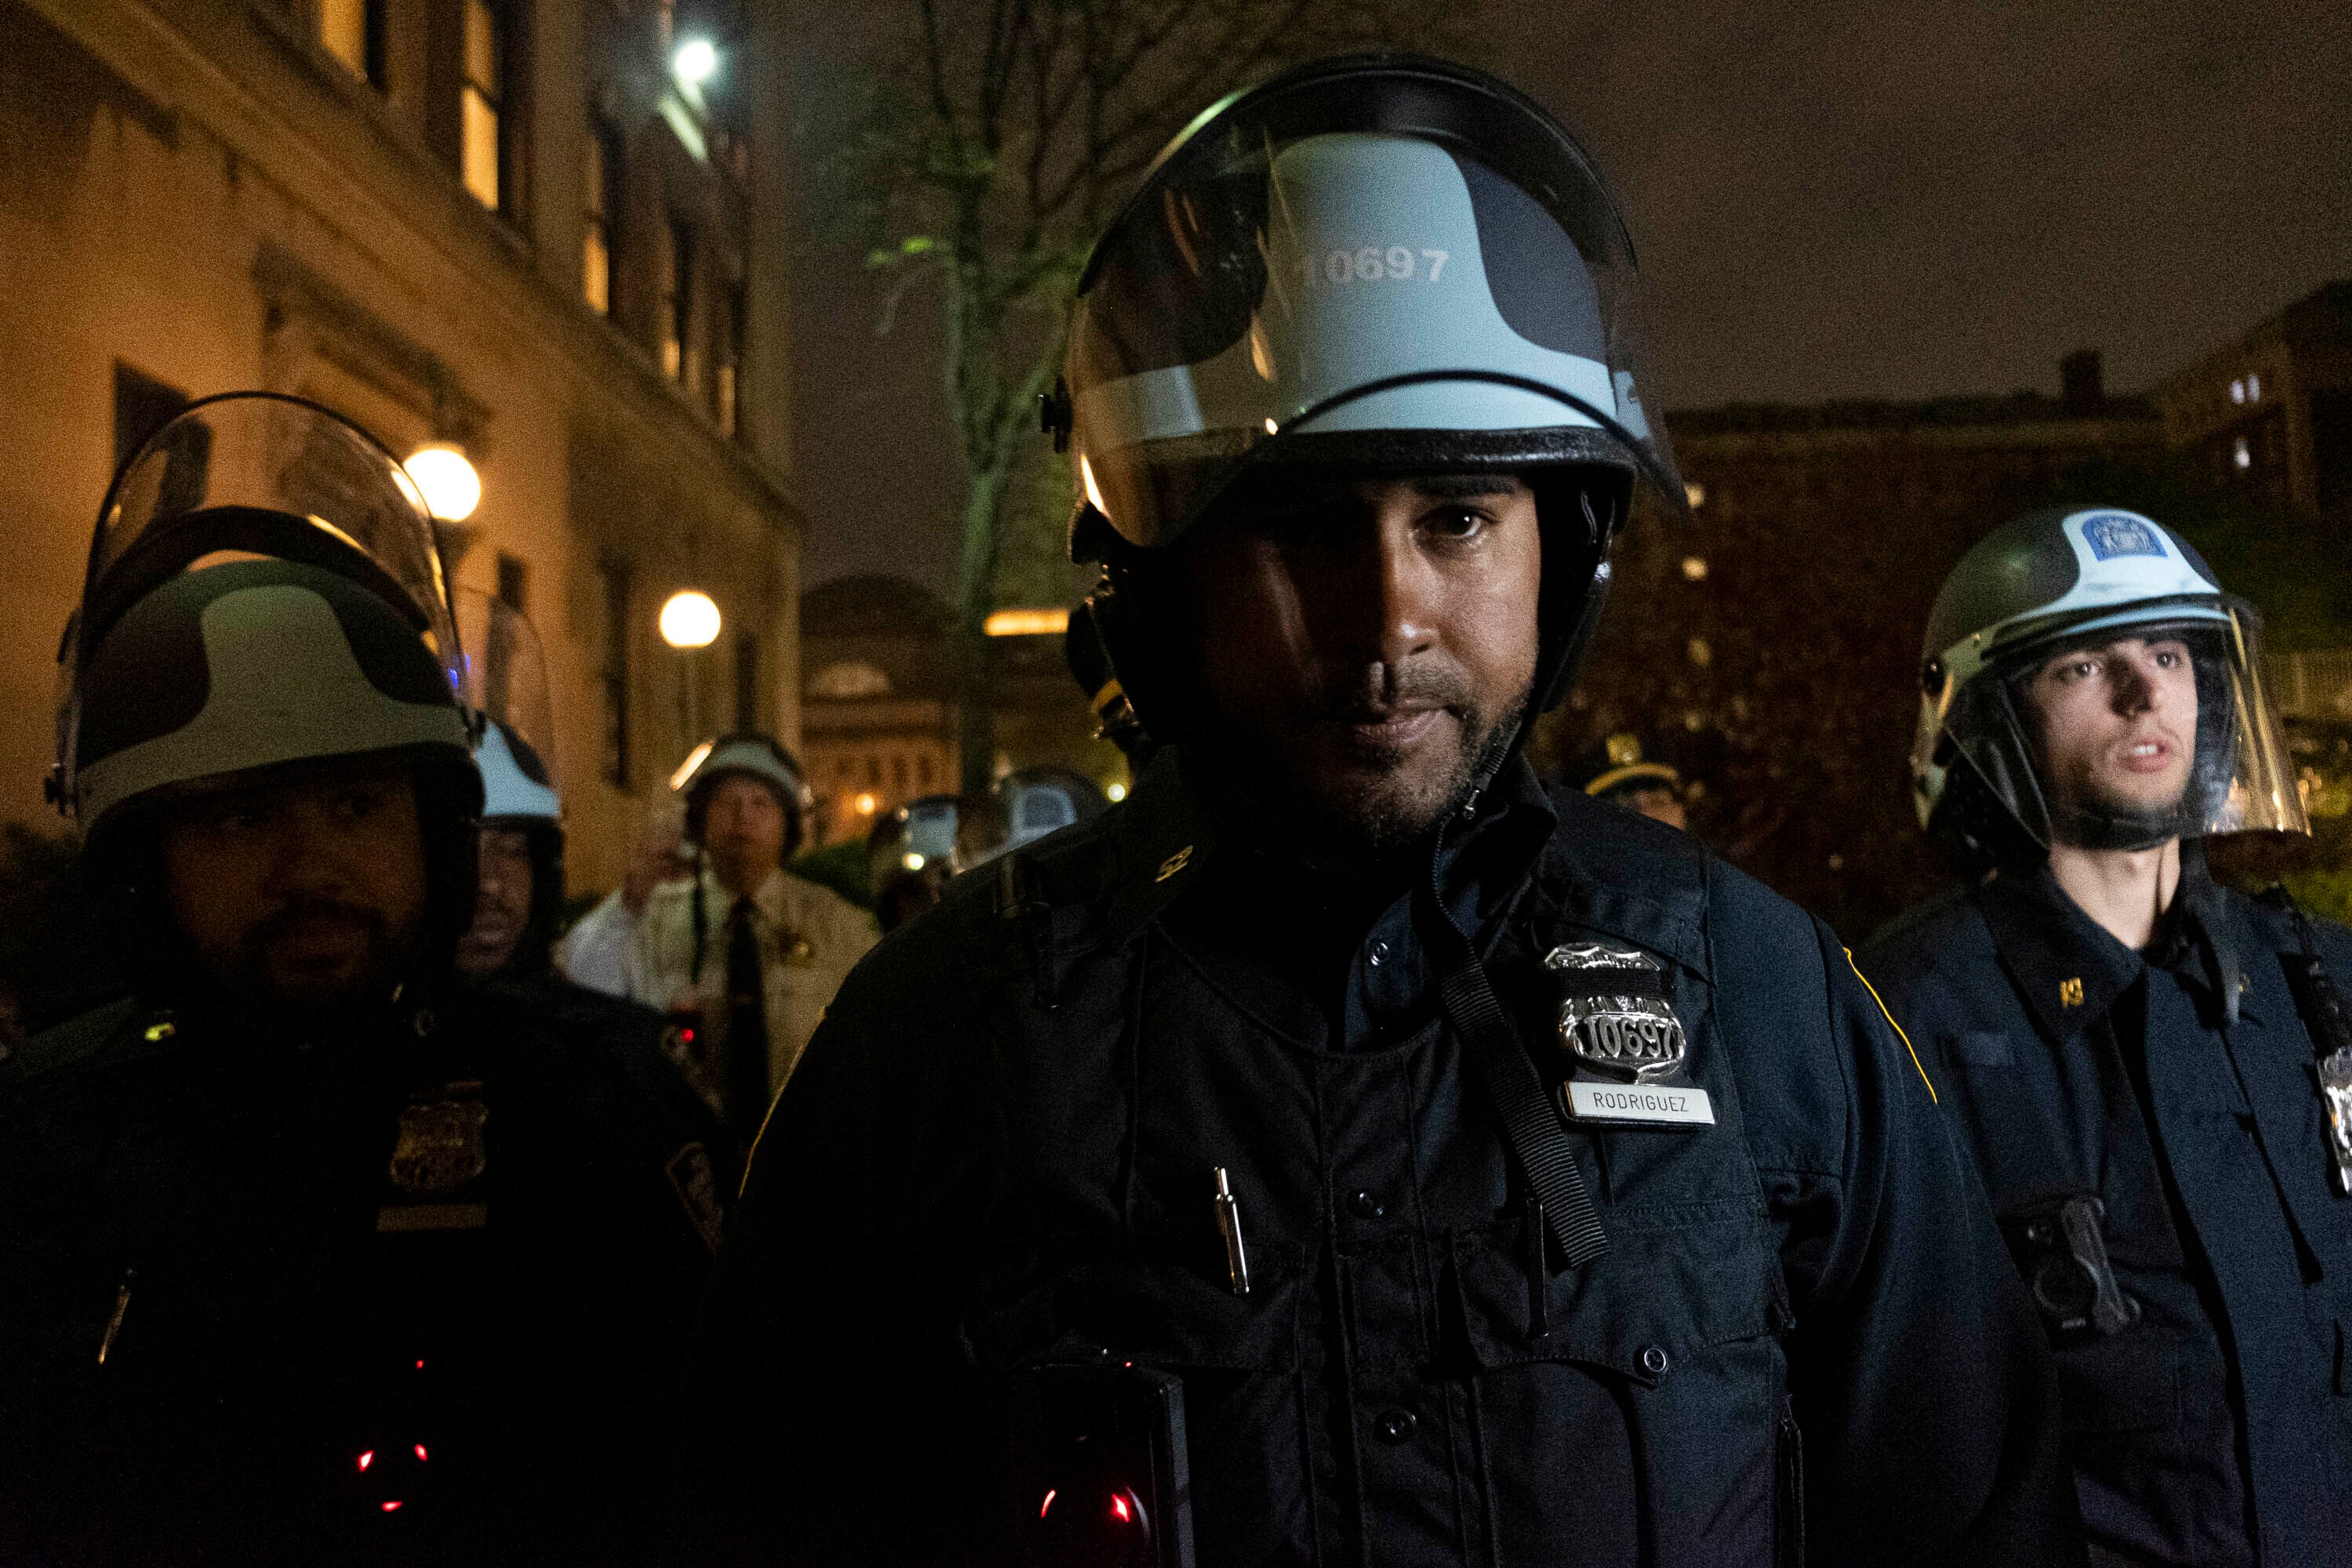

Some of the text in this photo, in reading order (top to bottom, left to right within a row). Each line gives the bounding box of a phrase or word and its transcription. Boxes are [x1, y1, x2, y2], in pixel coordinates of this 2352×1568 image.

[1293, 245, 1449, 287] 10697
[1584, 1015, 1673, 1059] 10697
[1592, 1092, 1690, 1112] RODRIGUEZ
